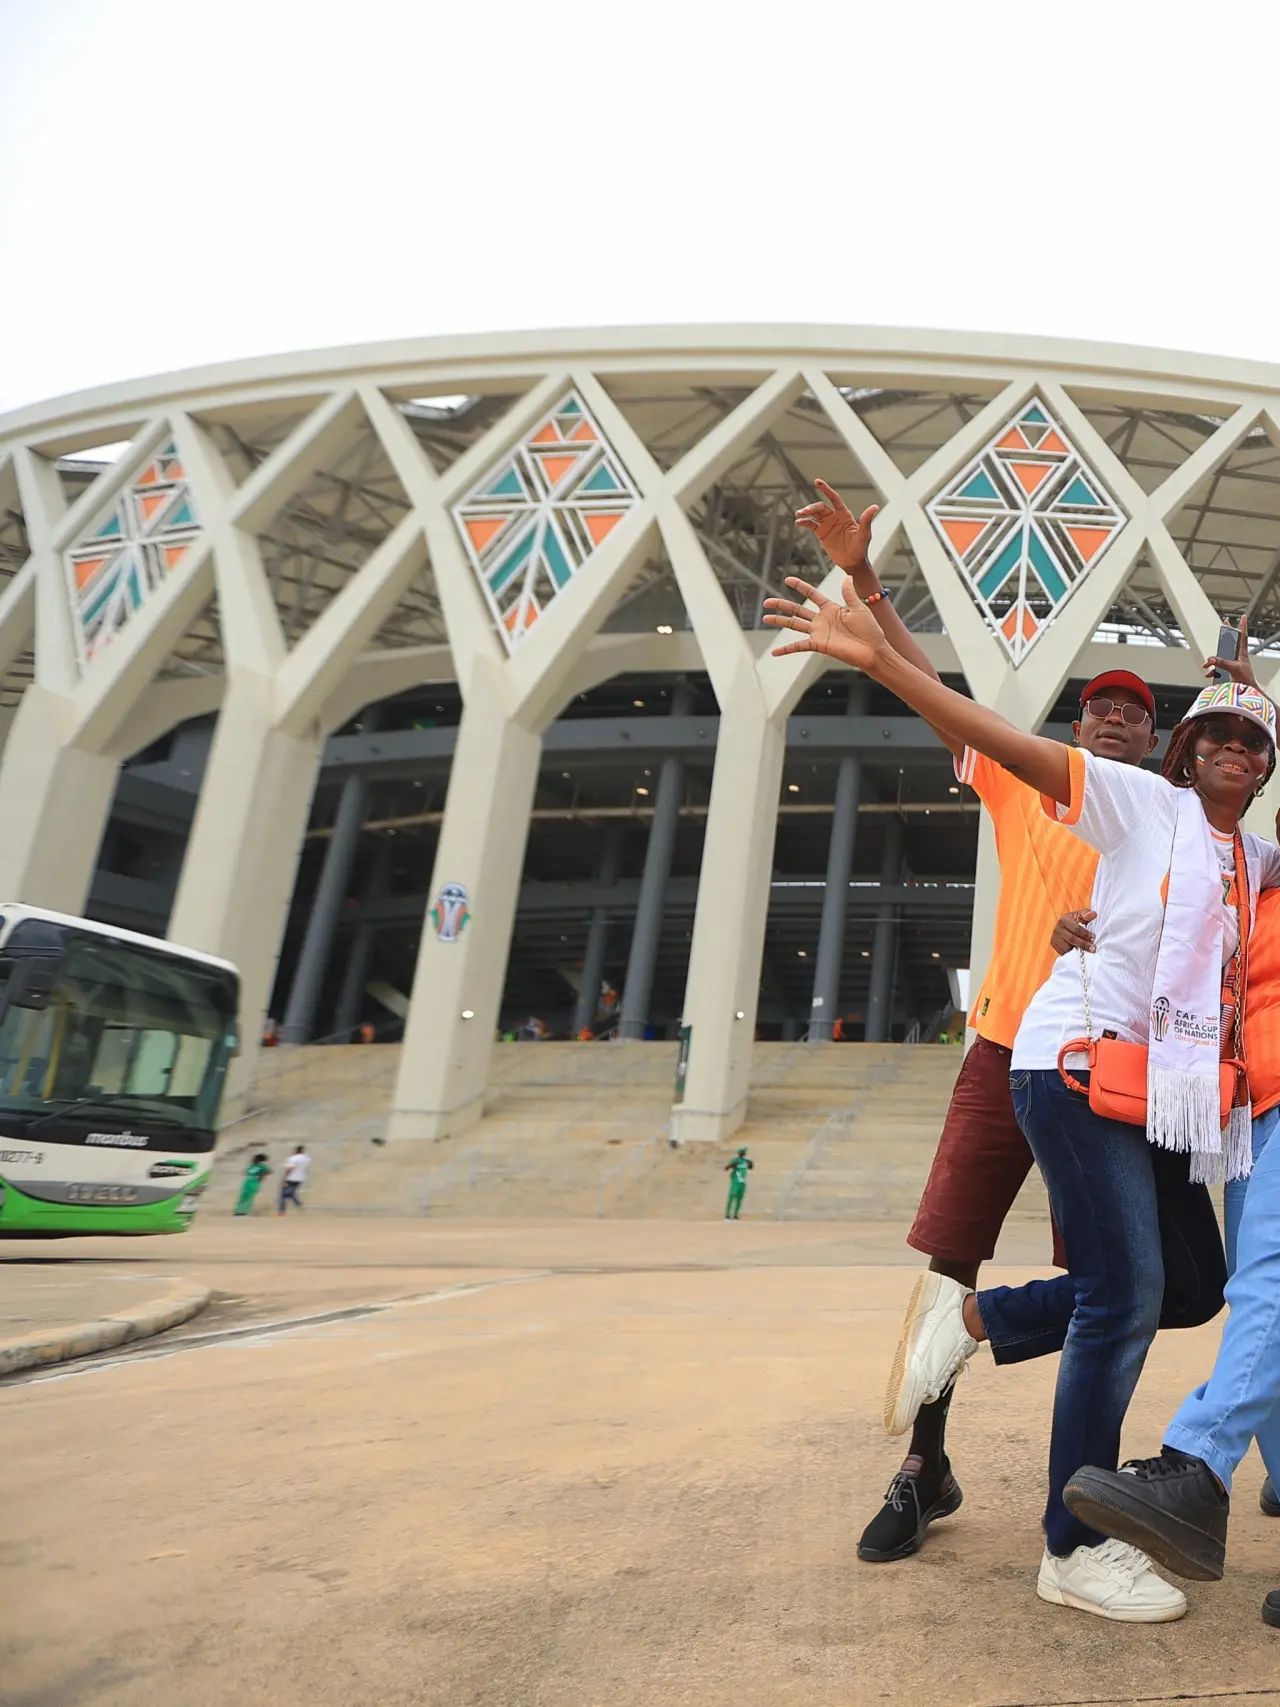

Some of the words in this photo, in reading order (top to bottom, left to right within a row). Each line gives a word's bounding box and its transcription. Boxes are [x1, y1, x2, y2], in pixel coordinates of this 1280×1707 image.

[1176, 1009, 1197, 1020] CAF
[1174, 1019, 1200, 1030] AFRICA
[1174, 1026, 1183, 1034] OF
[1184, 1030, 1218, 1040] NATIONS
[67, 1183, 138, 1200] IVECO
